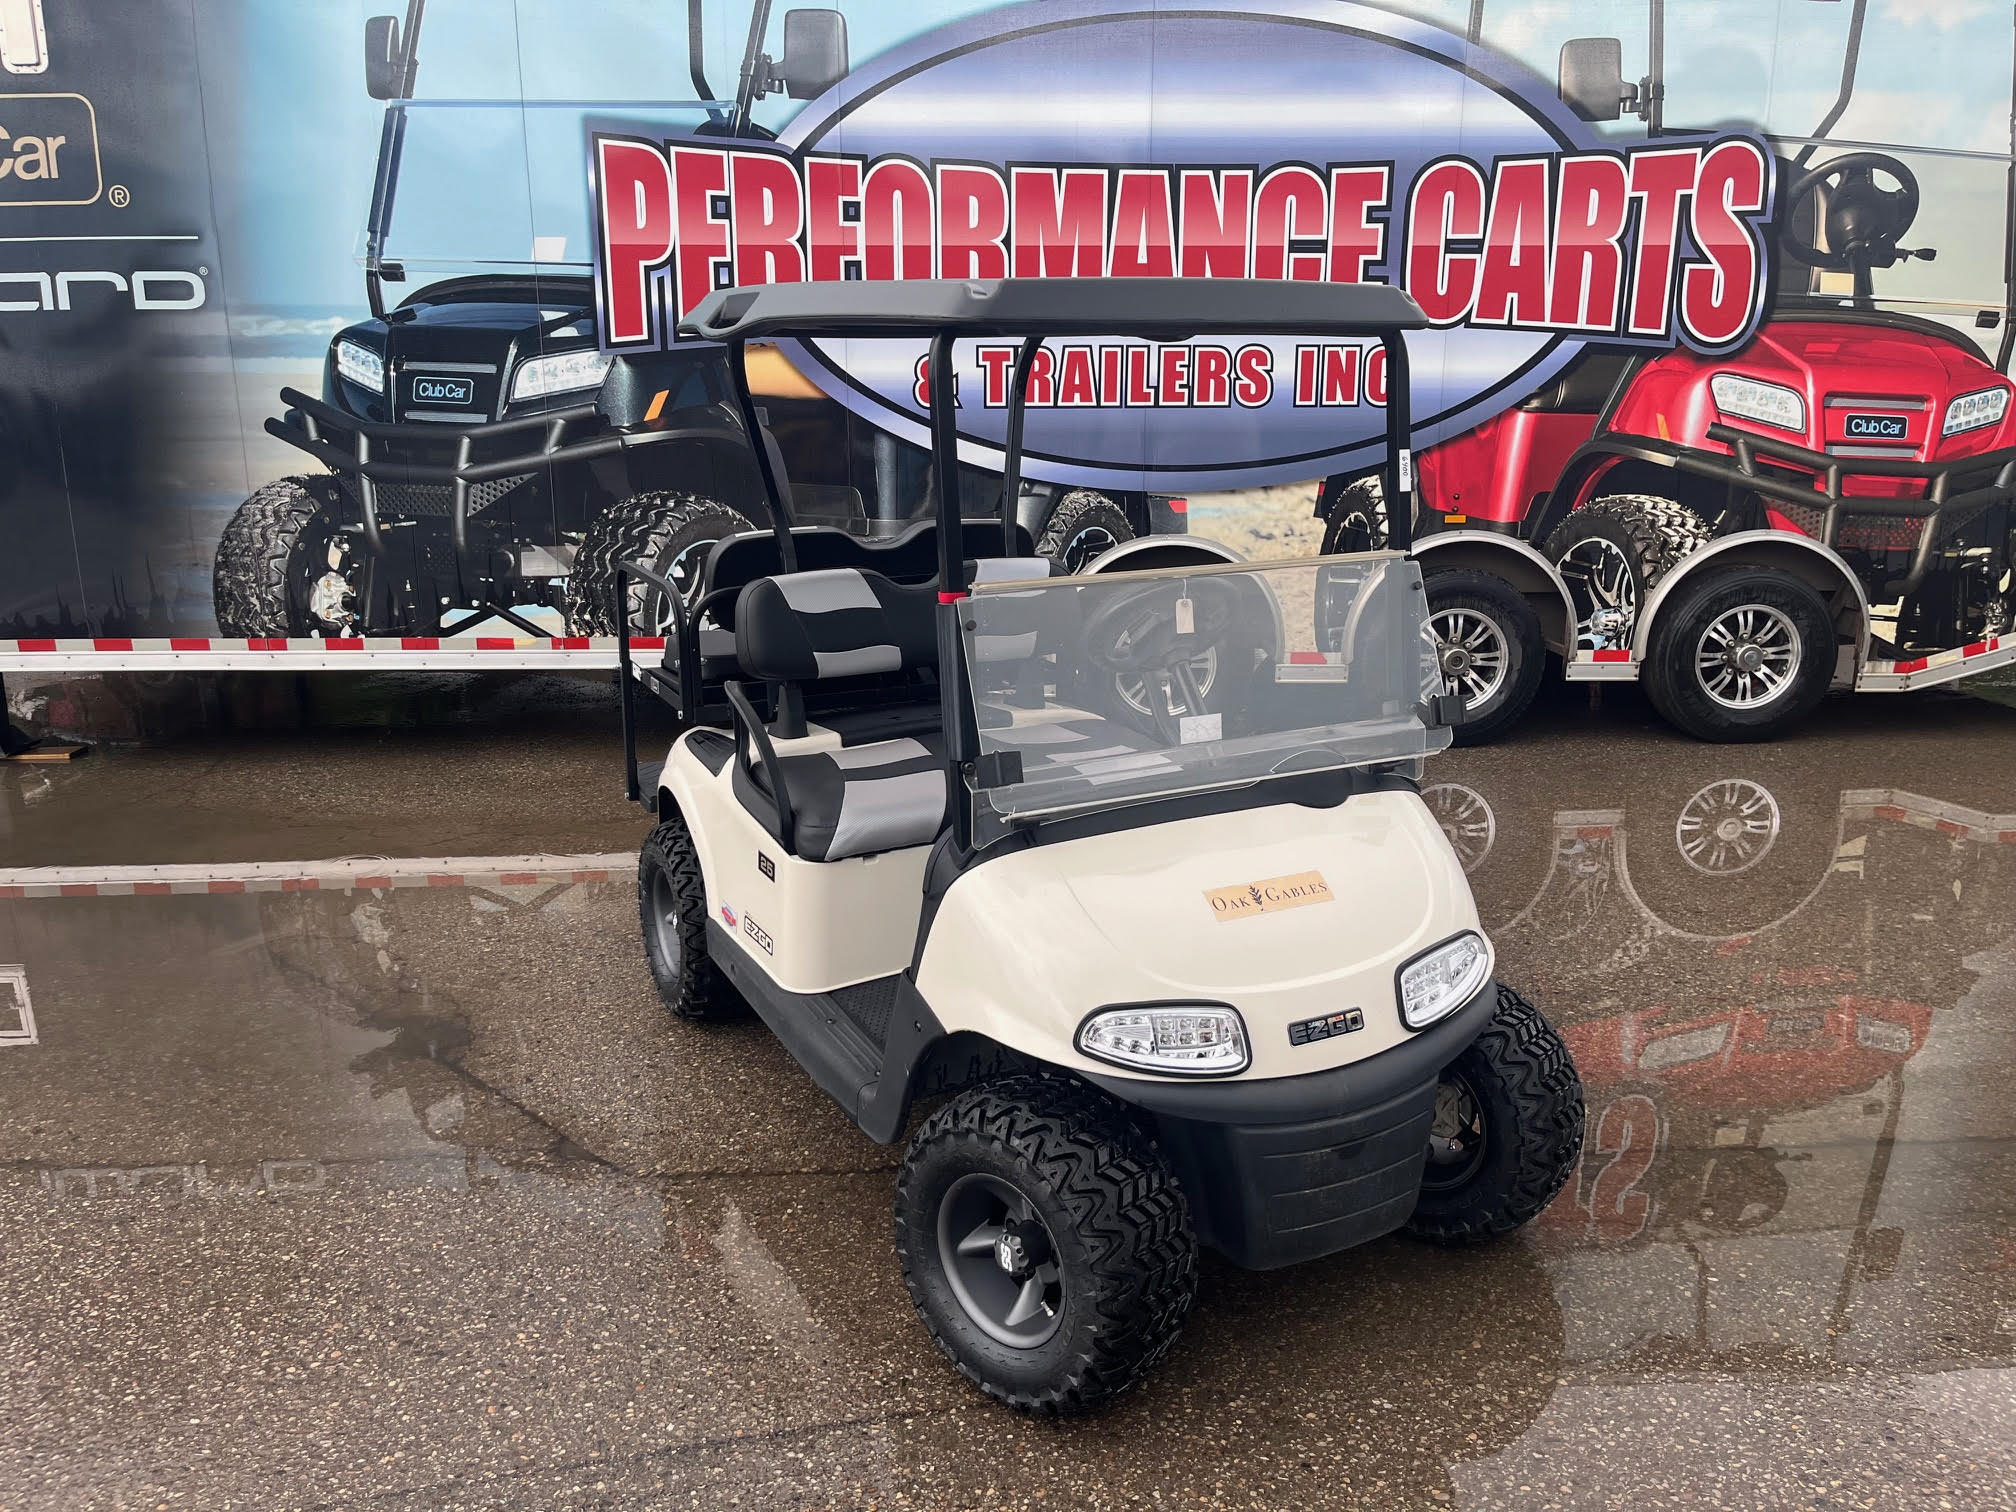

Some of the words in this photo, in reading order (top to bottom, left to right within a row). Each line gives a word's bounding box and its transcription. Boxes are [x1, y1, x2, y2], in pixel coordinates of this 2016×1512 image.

[598, 138, 1390, 342] PERFORMANCE
[1405, 140, 1766, 344] CARTS
[419, 382, 445, 398] Club
[445, 383, 467, 399] Car
[976, 344, 1274, 409] TRAILERS
[1851, 418, 1880, 434] Club
[1880, 420, 1902, 435] Car
[759, 855, 775, 879] 25
[744, 916, 773, 956] EZGO
[1289, 1010, 1364, 1046] EZGO
